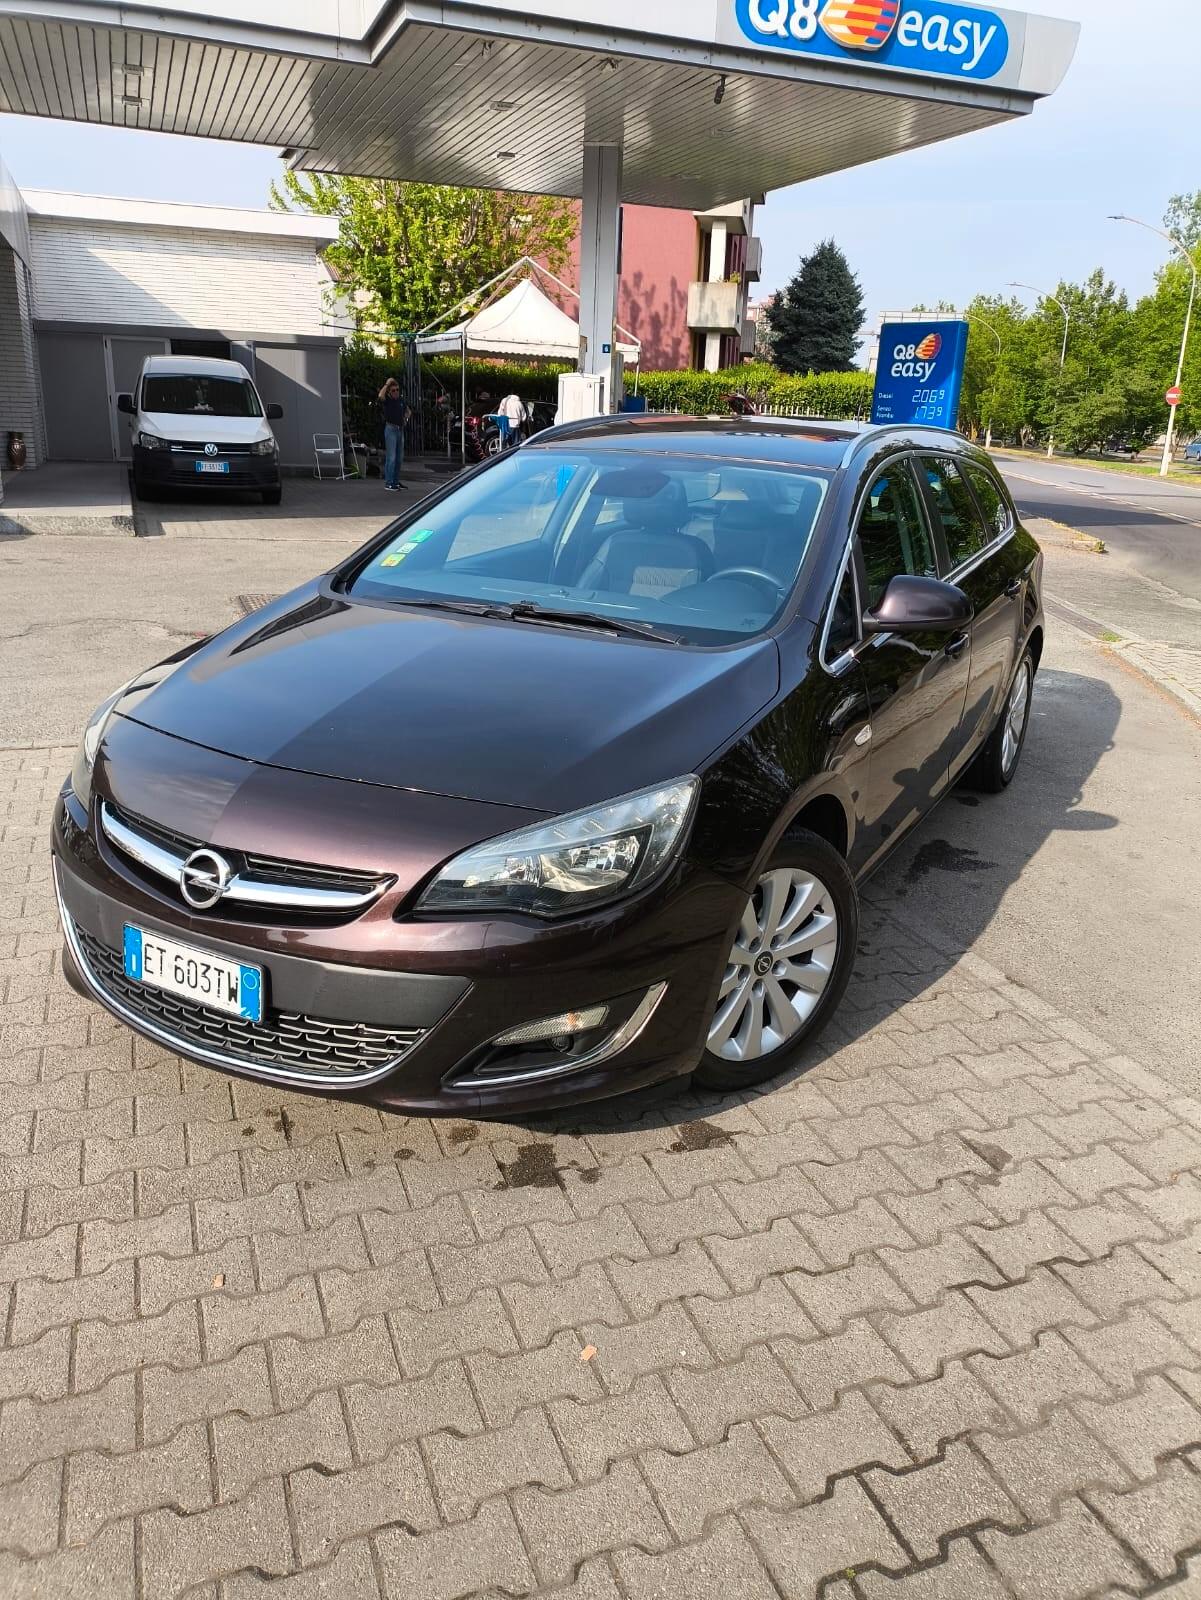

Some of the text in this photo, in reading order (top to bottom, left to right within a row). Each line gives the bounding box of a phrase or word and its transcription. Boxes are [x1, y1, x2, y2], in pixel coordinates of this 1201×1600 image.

[748, 0, 998, 71] Q8 easy
[891, 362, 936, 382] easy
[893, 344, 916, 360] Q8
[144, 943, 166, 976] ET
[174, 955, 239, 1003] 603TW
